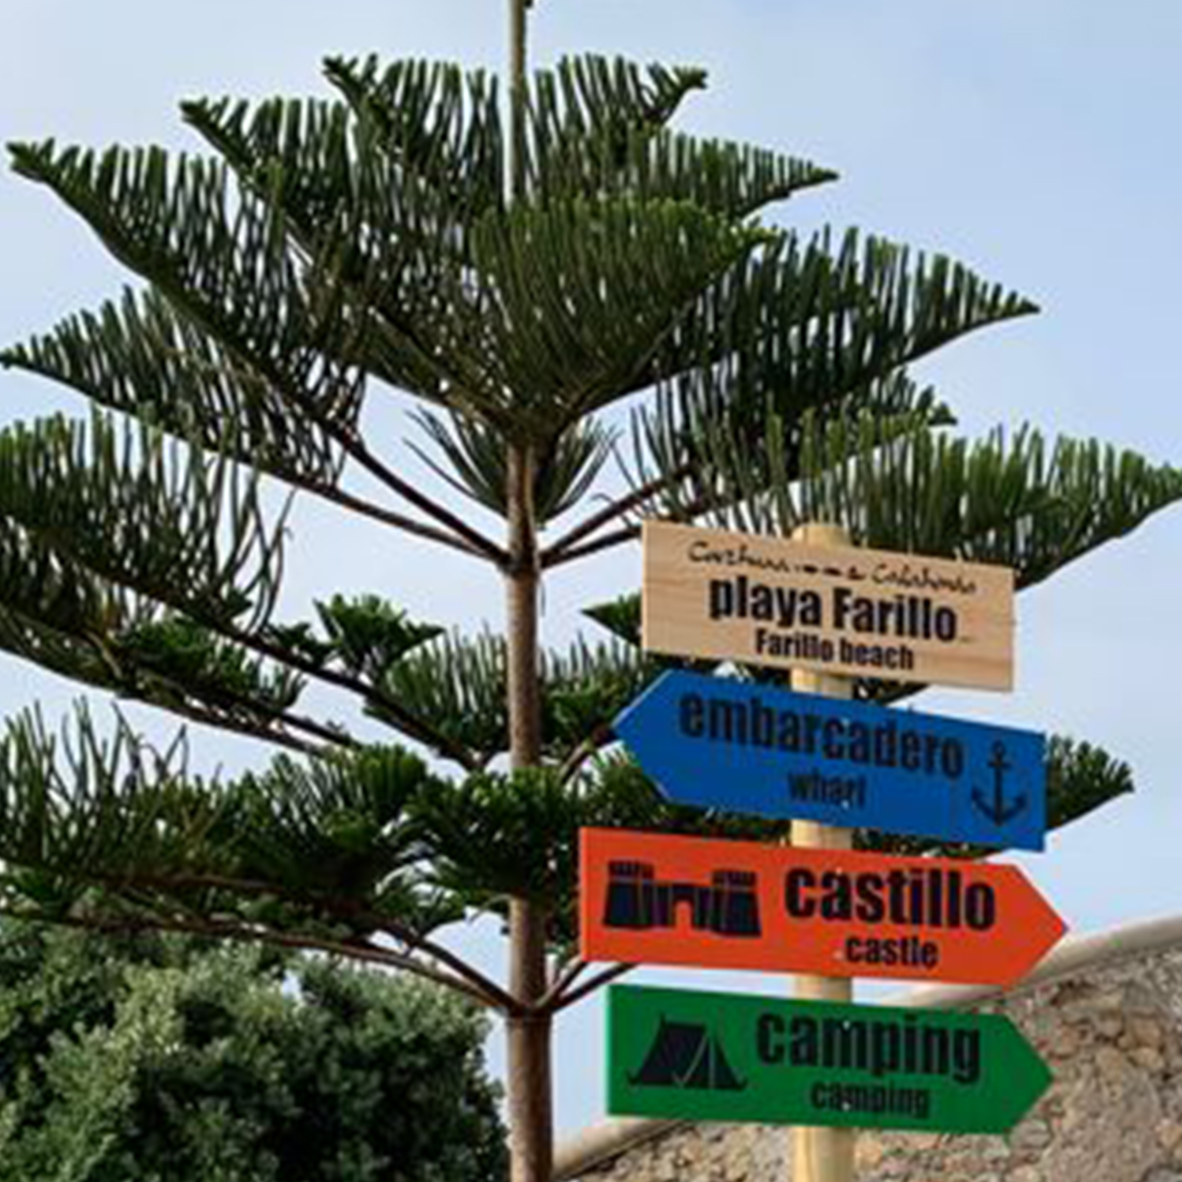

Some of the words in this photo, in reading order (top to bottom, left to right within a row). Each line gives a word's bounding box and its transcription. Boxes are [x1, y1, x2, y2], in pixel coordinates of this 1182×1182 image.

[709, 576, 822, 629] playa
[833, 587, 957, 643] Farillo
[755, 629, 834, 664] Farillo
[839, 640, 913, 670] beach
[678, 691, 964, 778] embarcadero
[787, 767, 866, 809] wharf
[845, 936, 938, 970] castle
[756, 1012, 981, 1084] camping
[811, 1080, 931, 1120] camping
